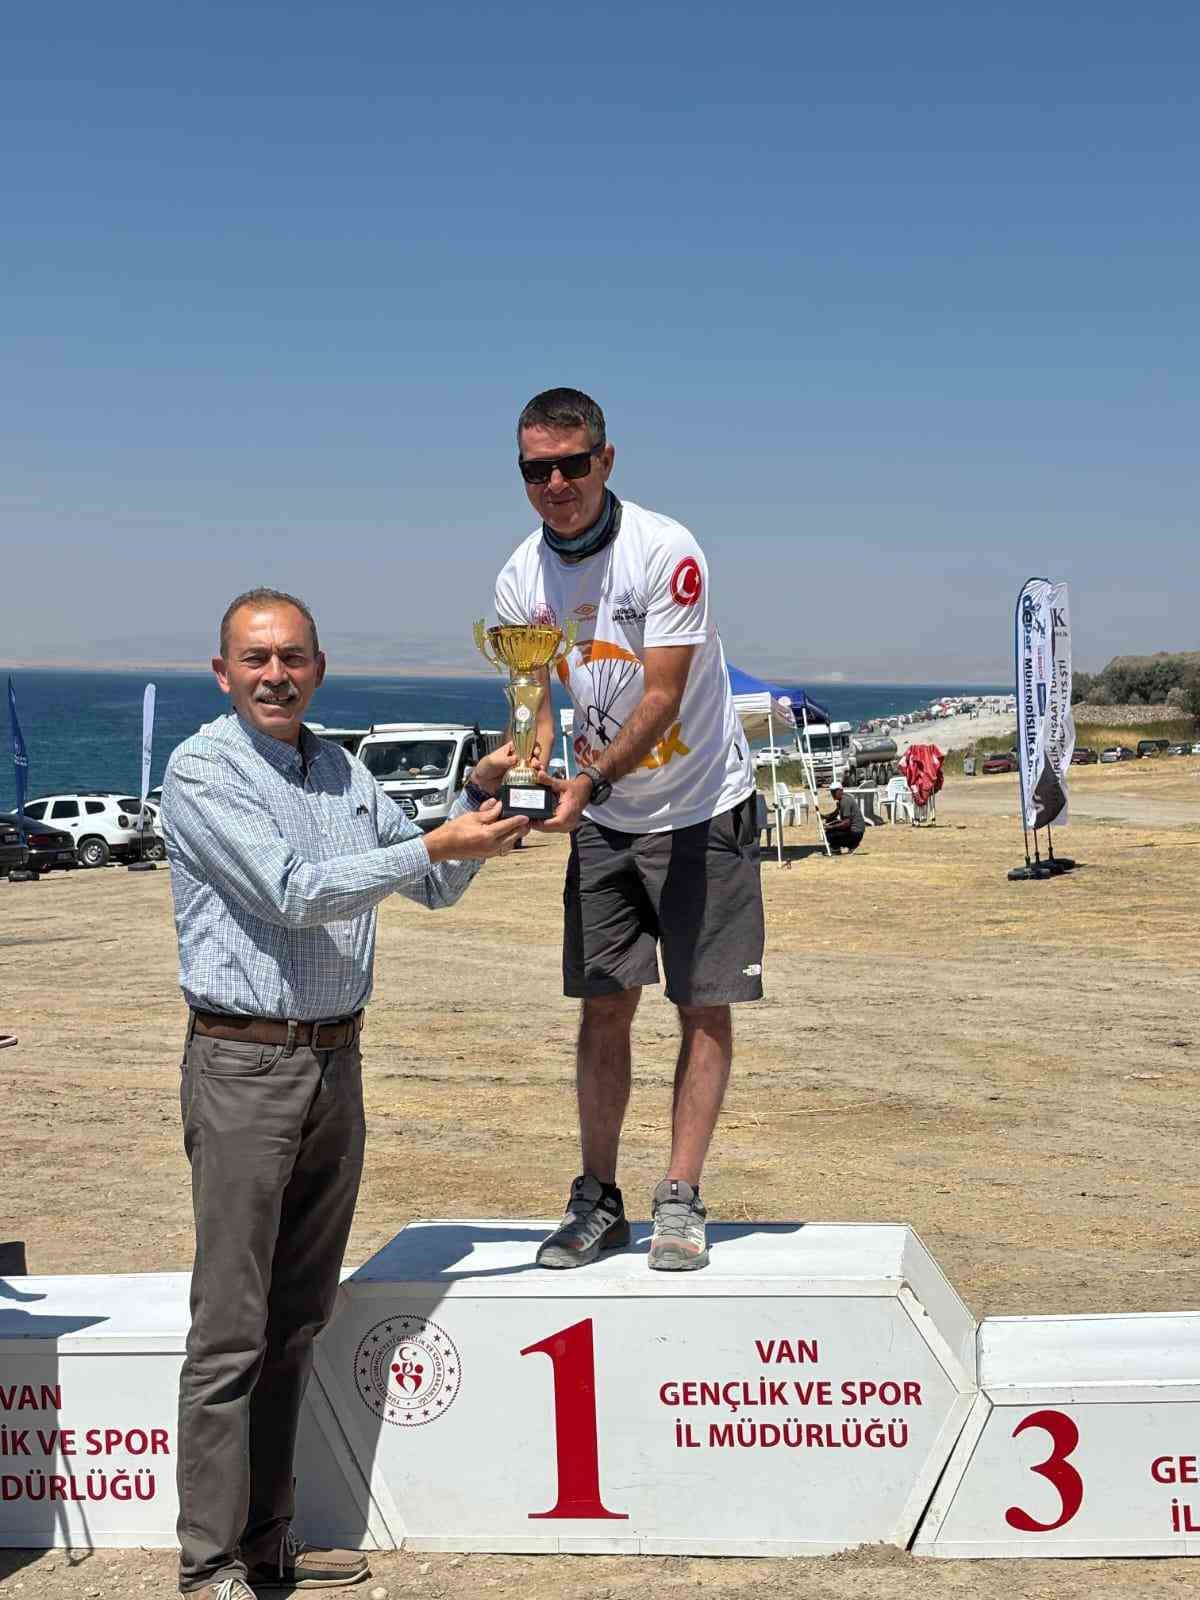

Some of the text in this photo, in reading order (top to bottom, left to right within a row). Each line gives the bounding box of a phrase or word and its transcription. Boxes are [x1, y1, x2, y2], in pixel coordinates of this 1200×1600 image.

[1024, 657, 1038, 744] MÜHENDİSLİK
[755, 1340, 818, 1363] VAN
[0, 1385, 62, 1410] VAN
[659, 1376, 922, 1412] GENÇLİK VE SPOR
[520, 1318, 628, 1519] 1
[675, 1418, 908, 1448] İL MÜDÜRLÜĞÜ
[36, 1430, 77, 1456] VE
[85, 1429, 170, 1456] SPOR
[2, 1468, 156, 1501] DÜRLÜĞÜ
[1005, 1410, 1083, 1532] 3
[1172, 1498, 1200, 1532] İL
